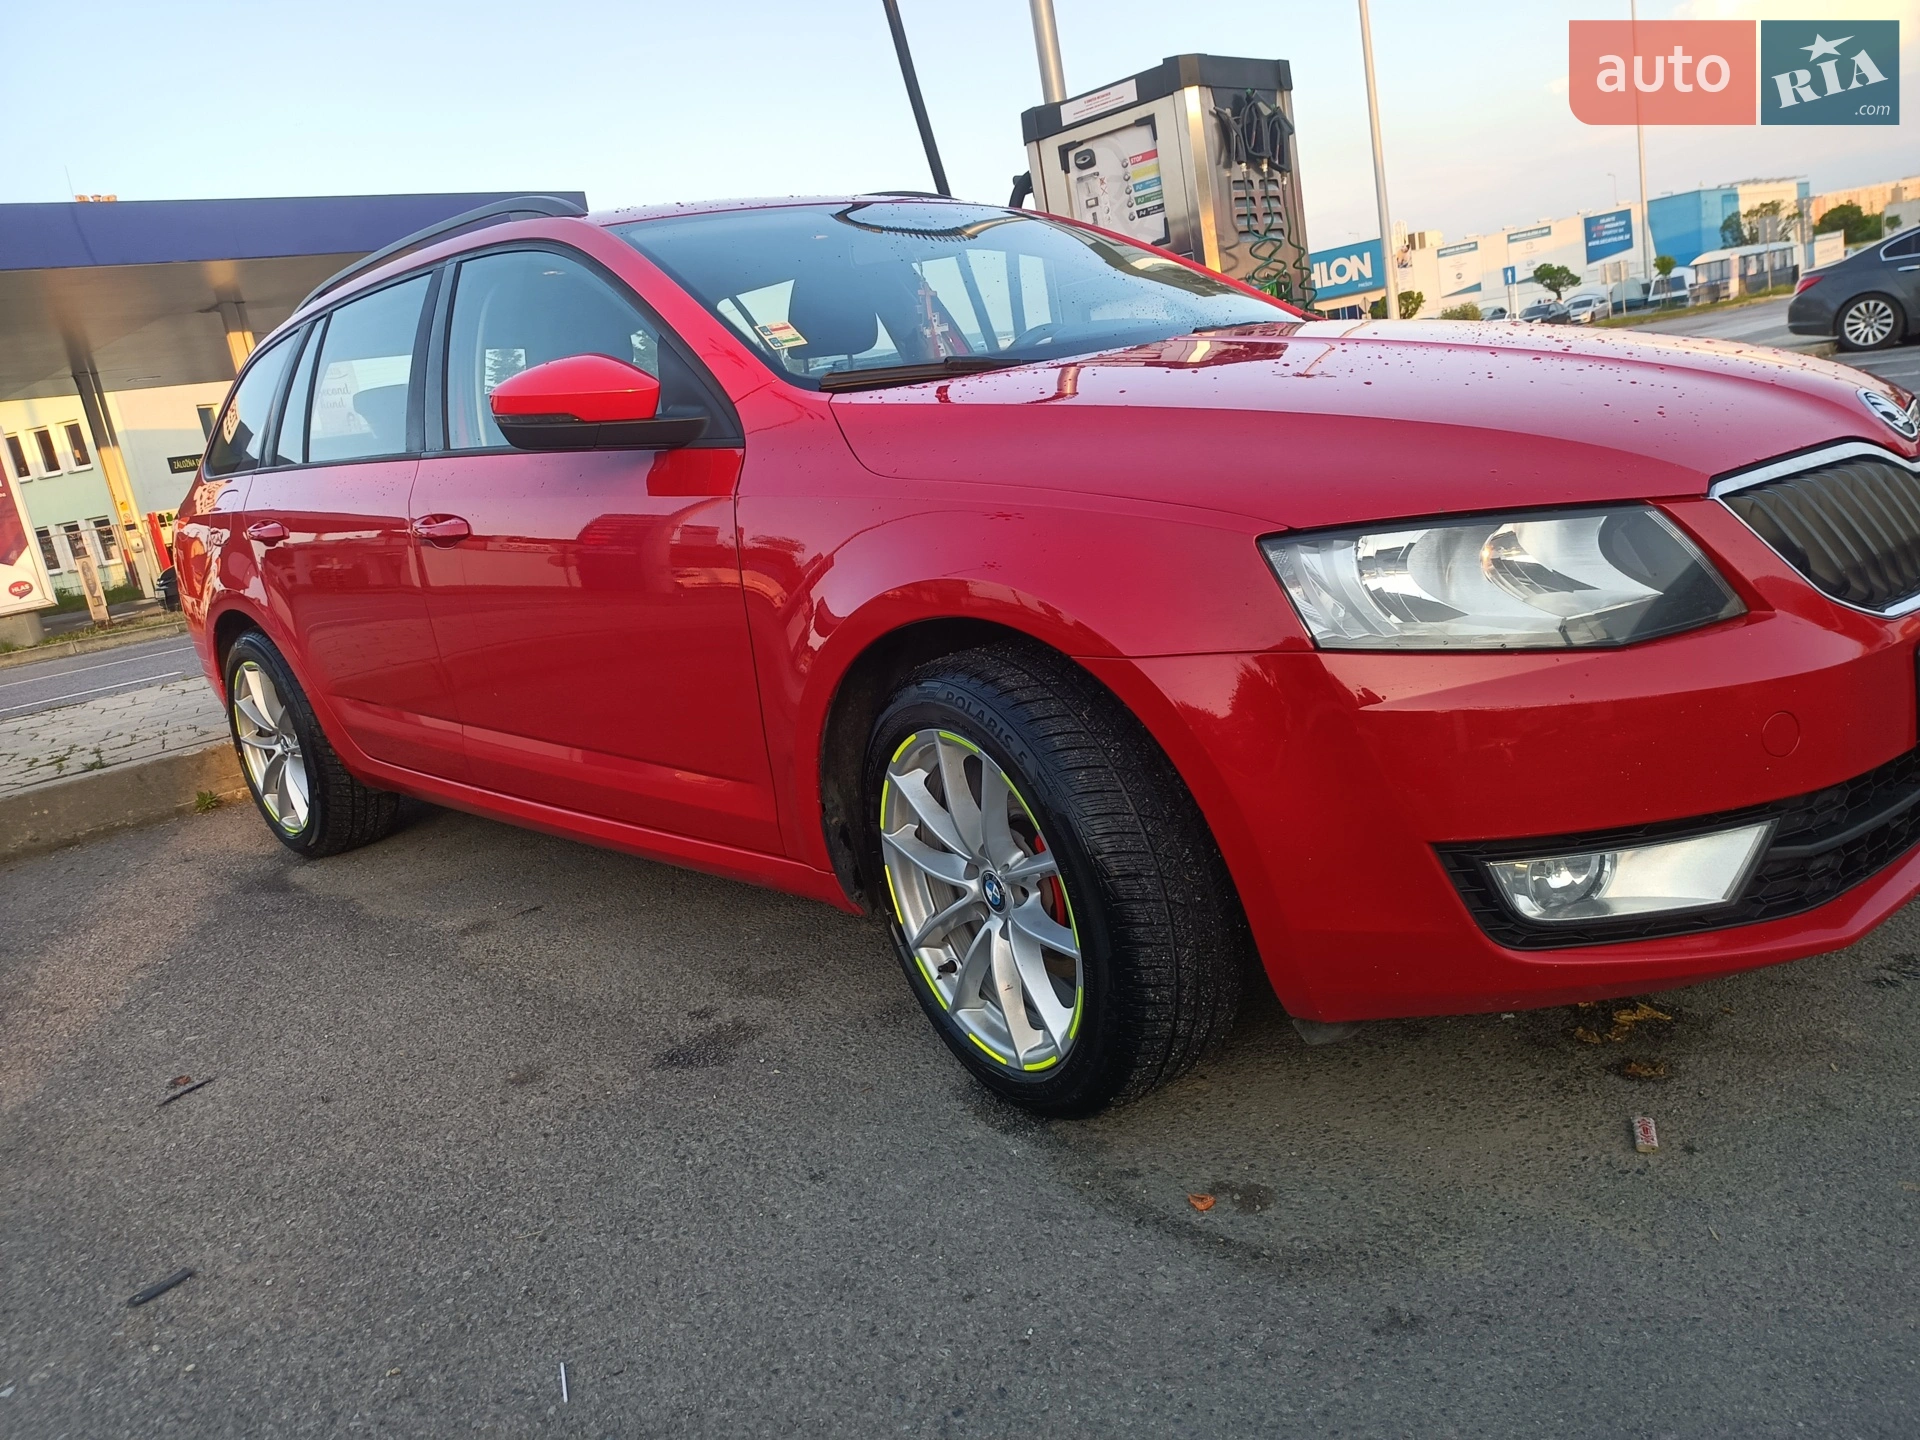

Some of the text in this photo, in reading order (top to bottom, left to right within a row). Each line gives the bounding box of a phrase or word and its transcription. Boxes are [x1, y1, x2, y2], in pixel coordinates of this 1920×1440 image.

[1131, 155, 1143, 164] STOP
[11, 584, 30, 593] HLAS
[946, 690, 1015, 752] POLARIS
